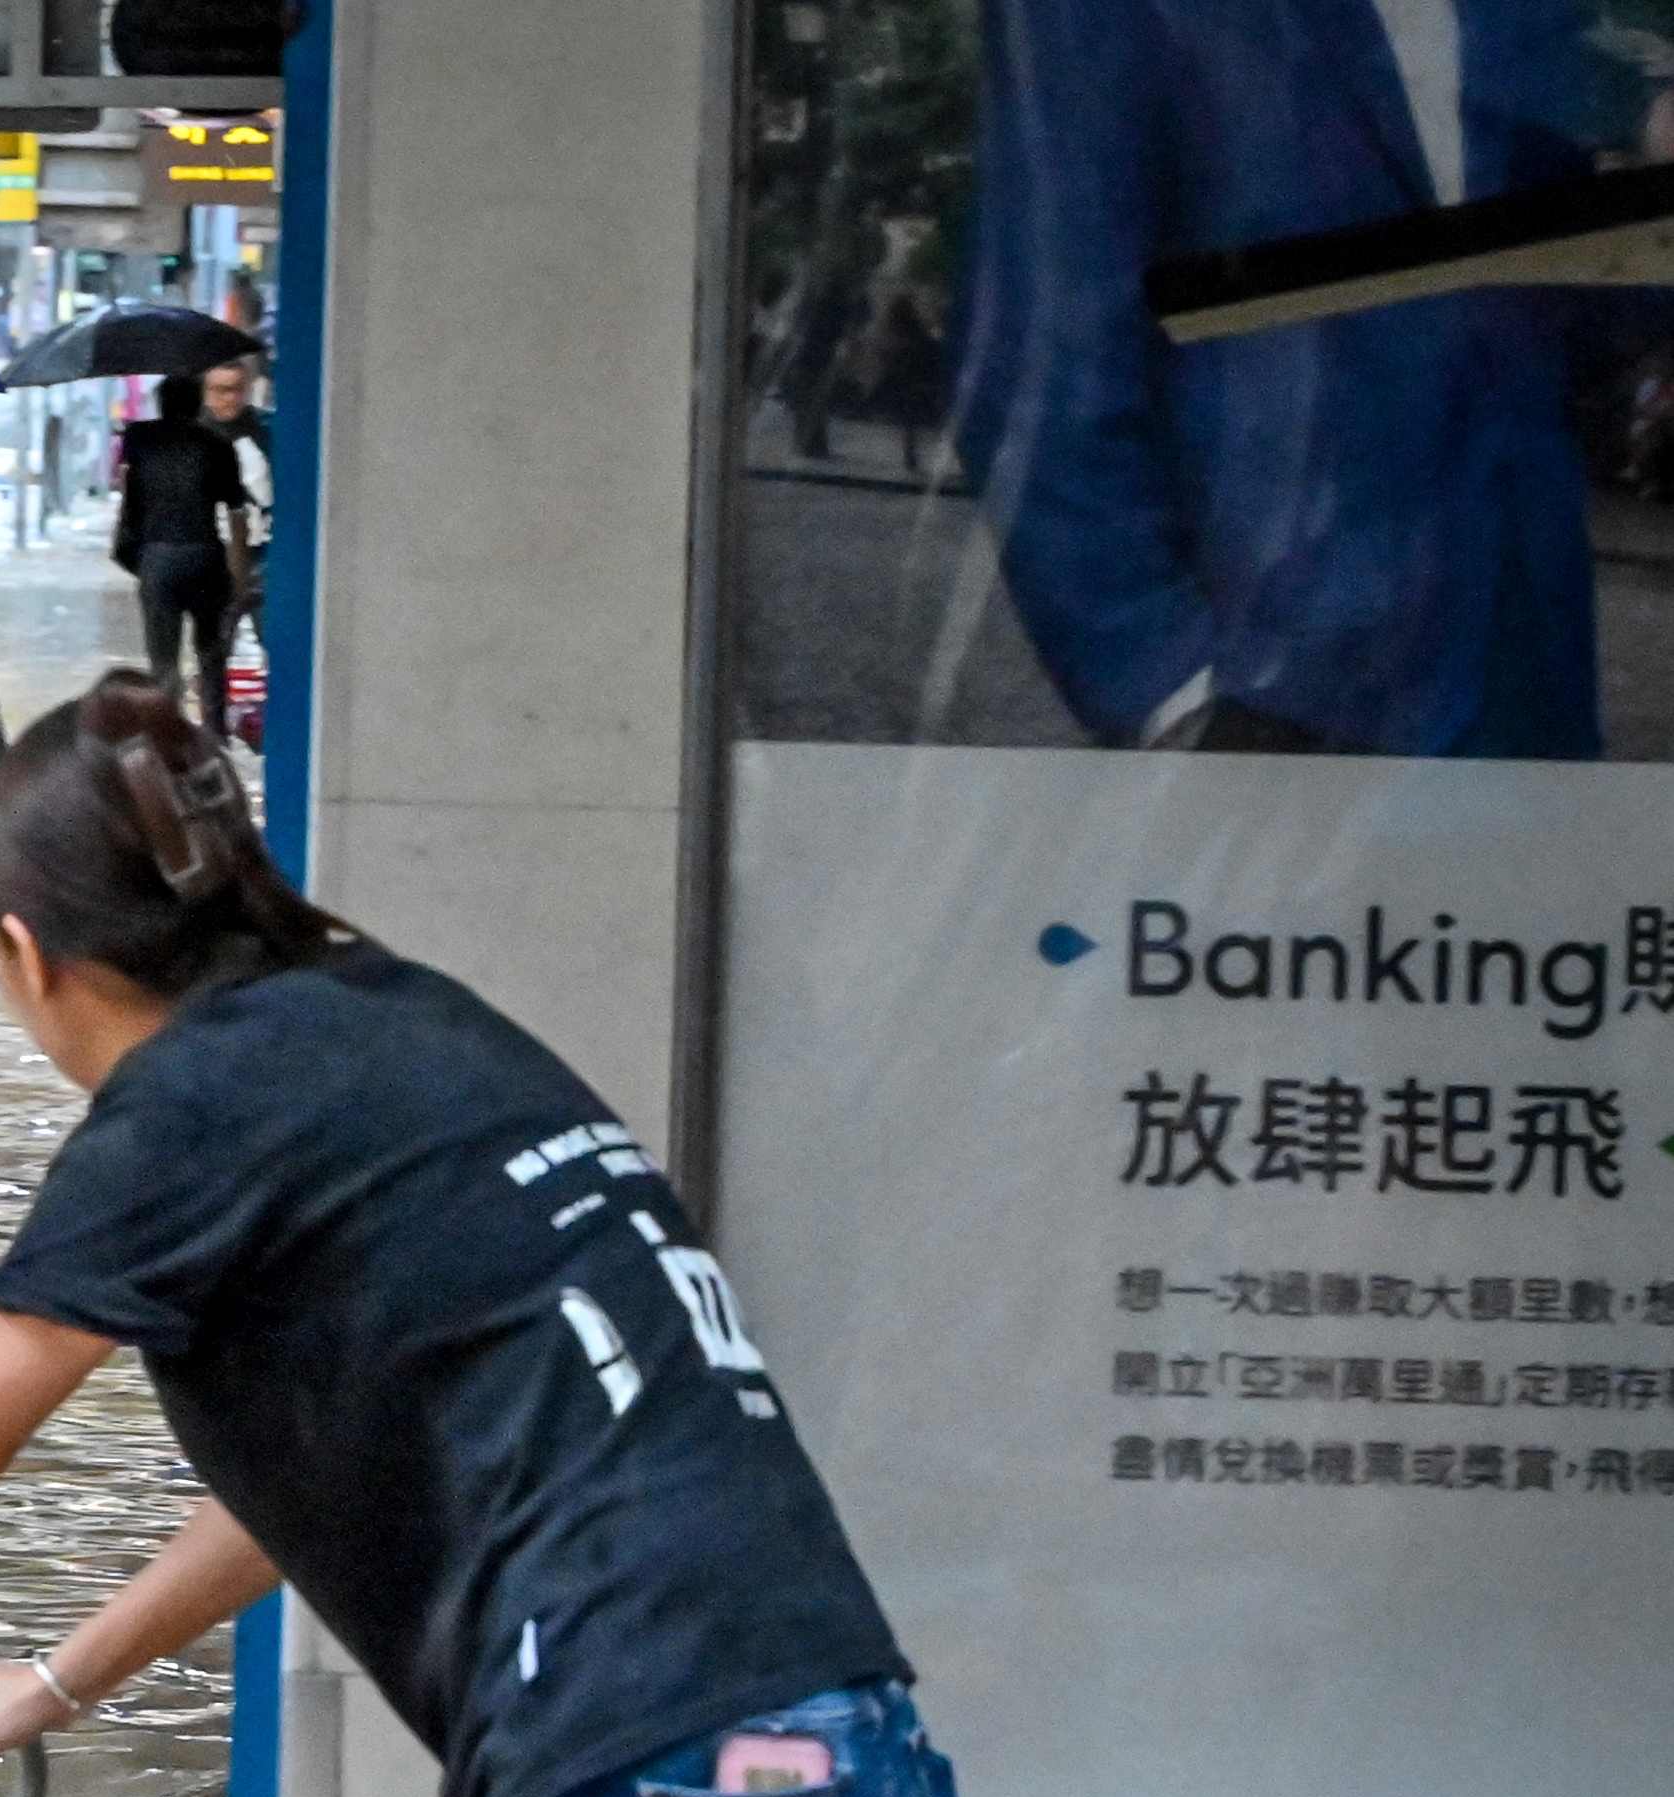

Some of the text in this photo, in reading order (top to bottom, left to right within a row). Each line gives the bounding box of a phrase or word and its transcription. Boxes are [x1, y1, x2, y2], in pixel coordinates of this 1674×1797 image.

[1122, 1071, 1625, 1199] 放肆起飛
[1113, 1351, 1674, 1410] 開立「亞洲萬里通」定期存
